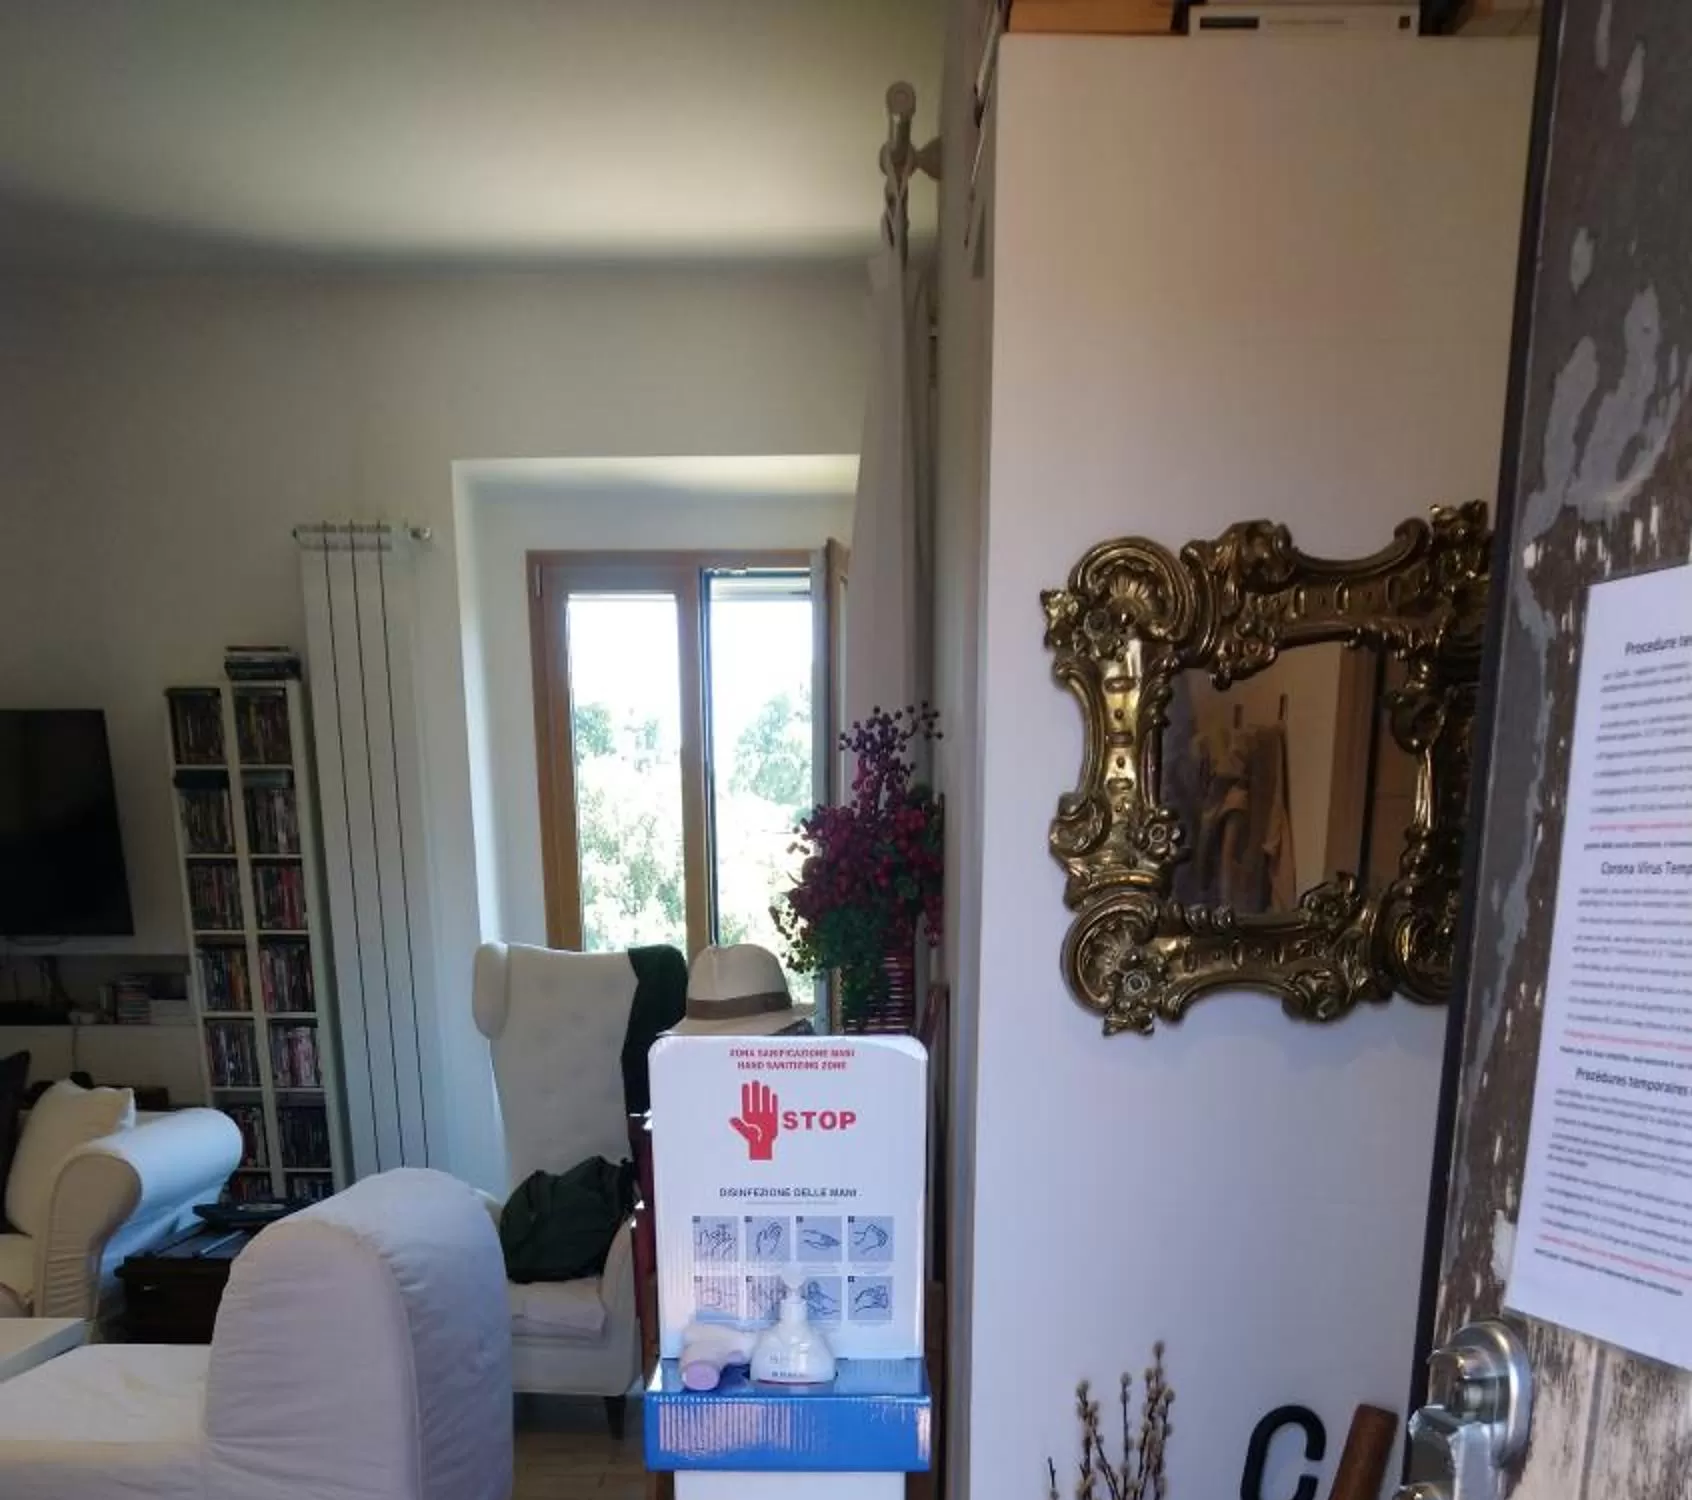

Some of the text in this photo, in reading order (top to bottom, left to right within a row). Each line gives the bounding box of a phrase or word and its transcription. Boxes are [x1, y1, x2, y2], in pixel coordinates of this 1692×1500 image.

[1601, 861, 1635, 875] Corona
[1637, 861, 1663, 875] Virus
[783, 1111, 857, 1130] STOP
[719, 1187, 791, 1197] DISINFEZIONE
[793, 1187, 827, 1197] DELLE
